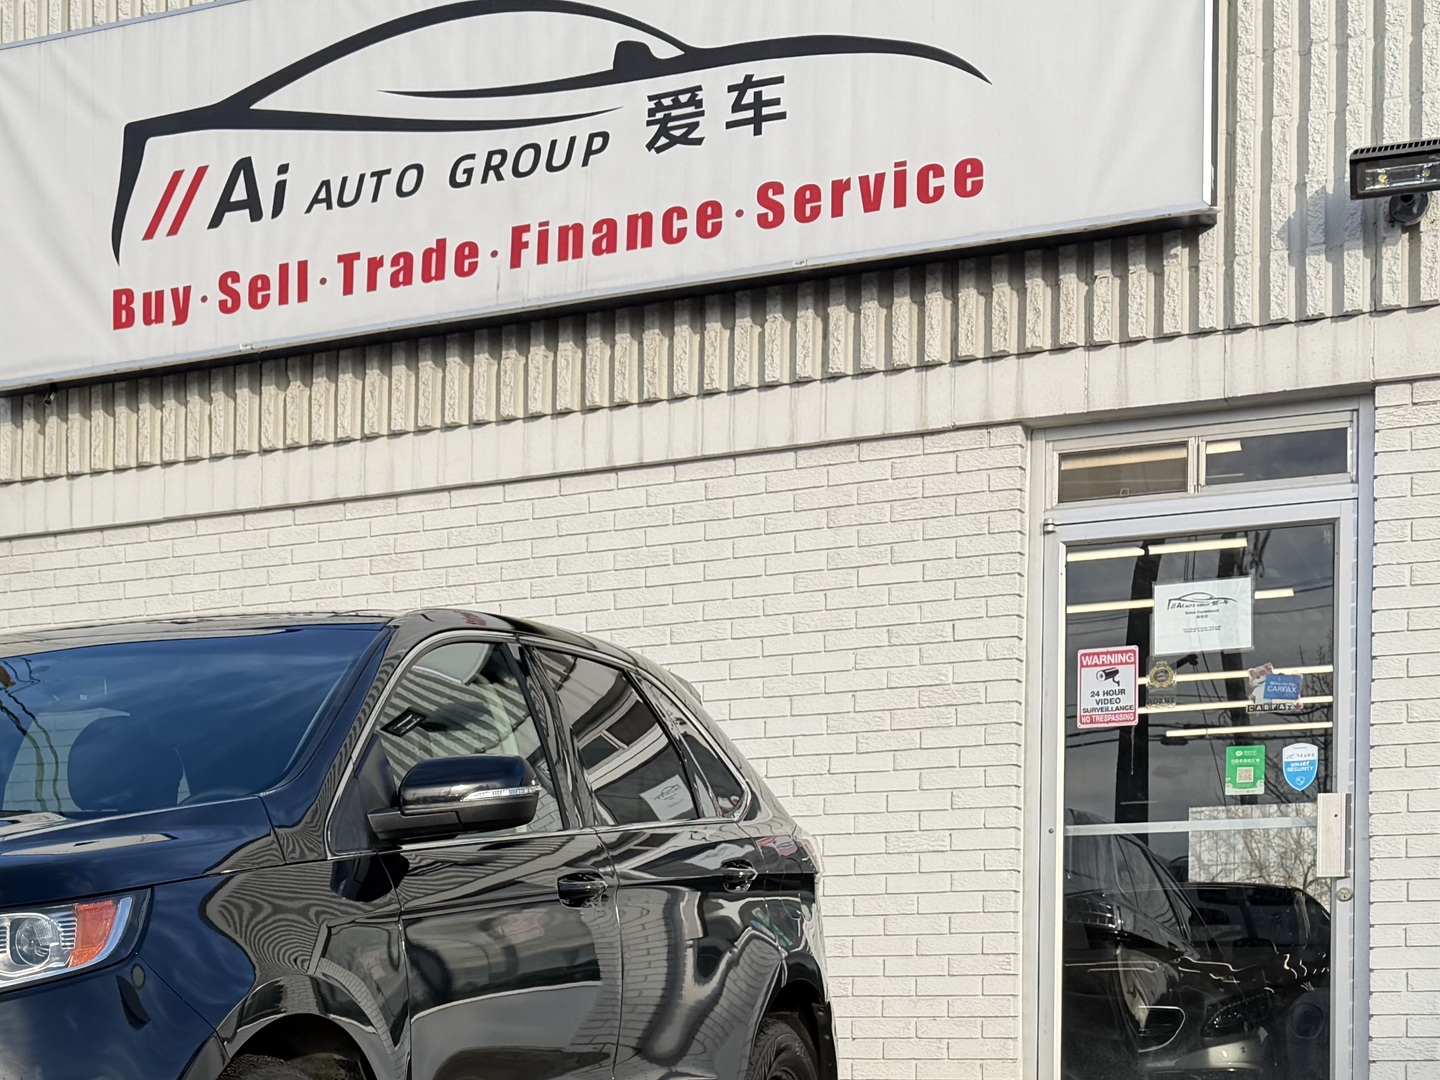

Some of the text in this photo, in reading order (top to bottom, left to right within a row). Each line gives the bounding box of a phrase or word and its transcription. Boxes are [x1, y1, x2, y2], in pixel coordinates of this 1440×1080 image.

[645, 74, 788, 155] 爱车
[207, 131, 610, 230] Ai AUTO GROUP
[112, 156, 986, 331] Buy Sell Trade Finance Service
[1081, 652, 1135, 666] WARNING
[1090, 688, 1126, 698] 24 HOUR
[1267, 685, 1297, 693] CARFAX
[1094, 697, 1122, 706] VIDEO
[1082, 704, 1134, 714] SURVEILLANCE
[1081, 712, 1135, 723] NO TRESPASSING
